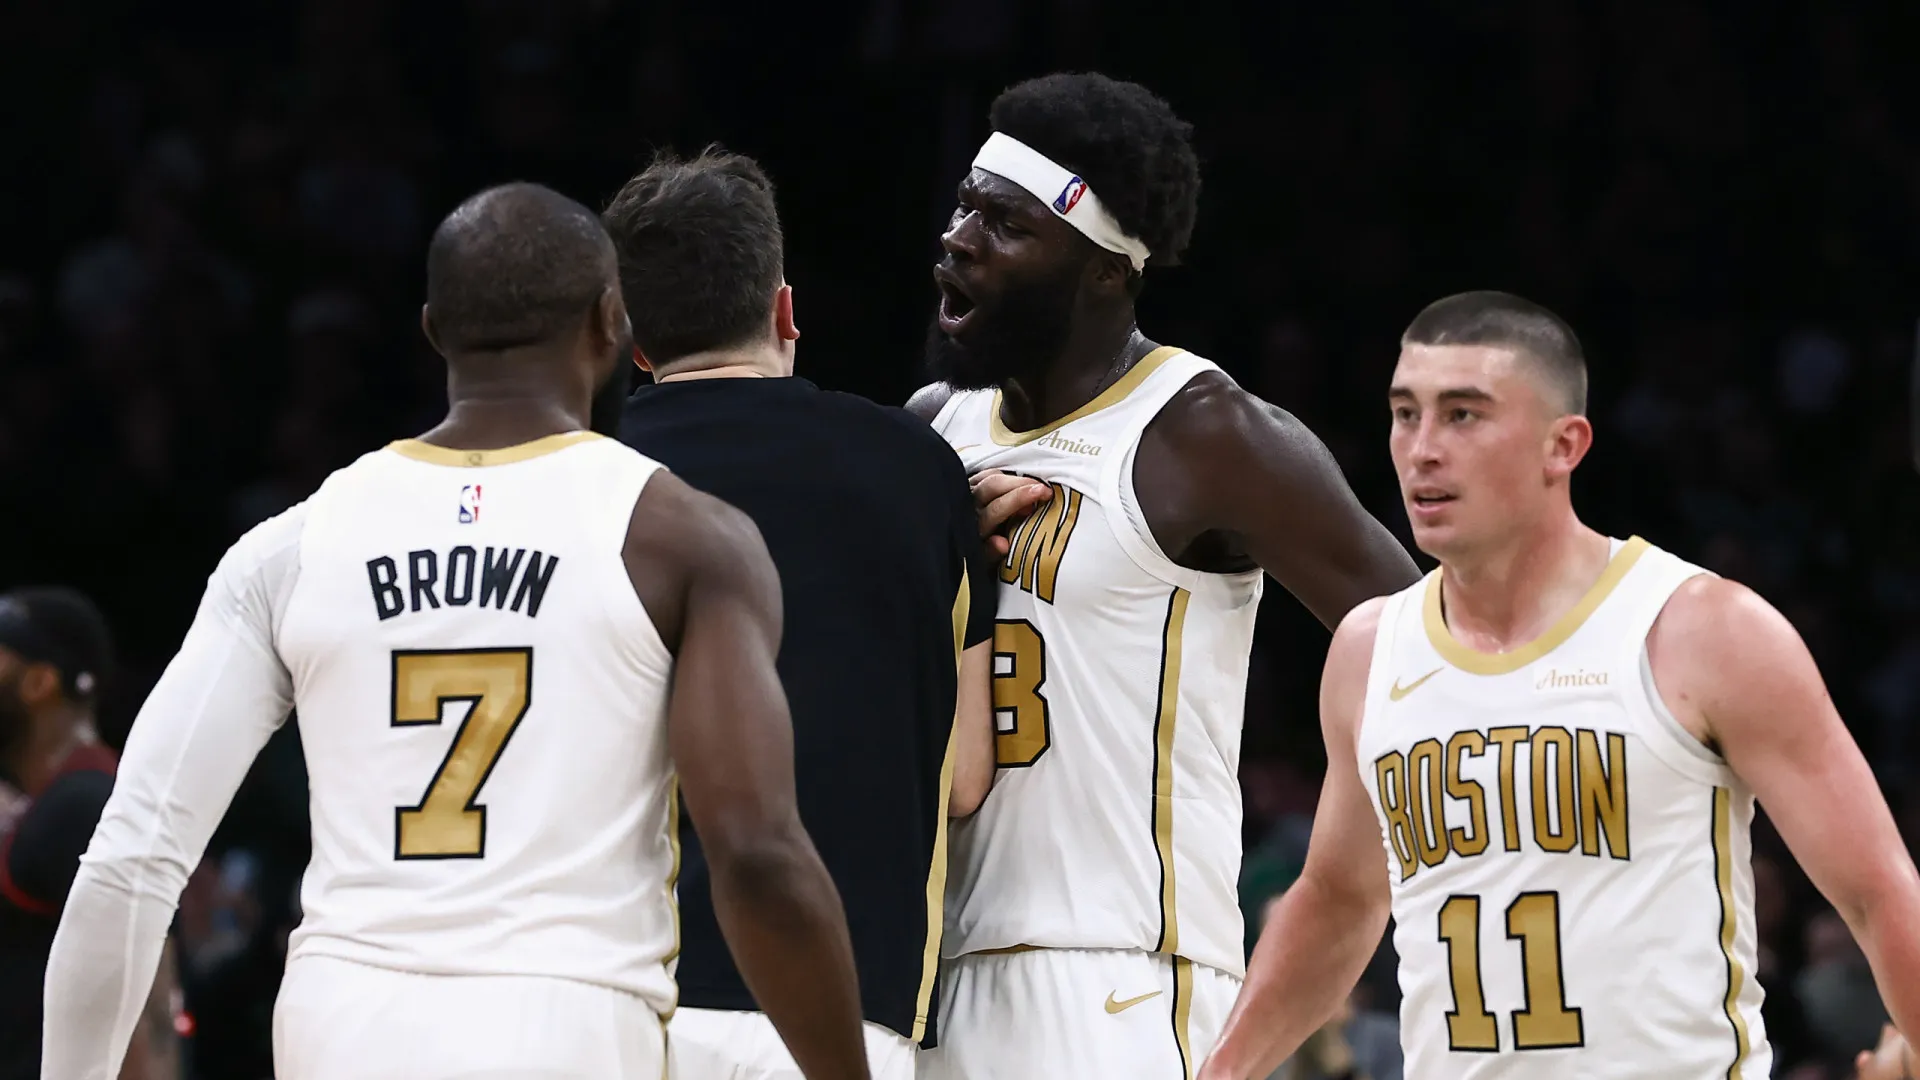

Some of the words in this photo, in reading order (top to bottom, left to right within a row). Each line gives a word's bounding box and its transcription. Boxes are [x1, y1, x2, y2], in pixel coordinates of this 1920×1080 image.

[1038, 430, 1102, 456] Amica
[366, 545, 559, 621] BROWN
[1536, 668, 1608, 690] Amica
[390, 646, 533, 860] 7
[1375, 725, 1631, 883] BOSTON
[1438, 891, 1585, 1052] 11
